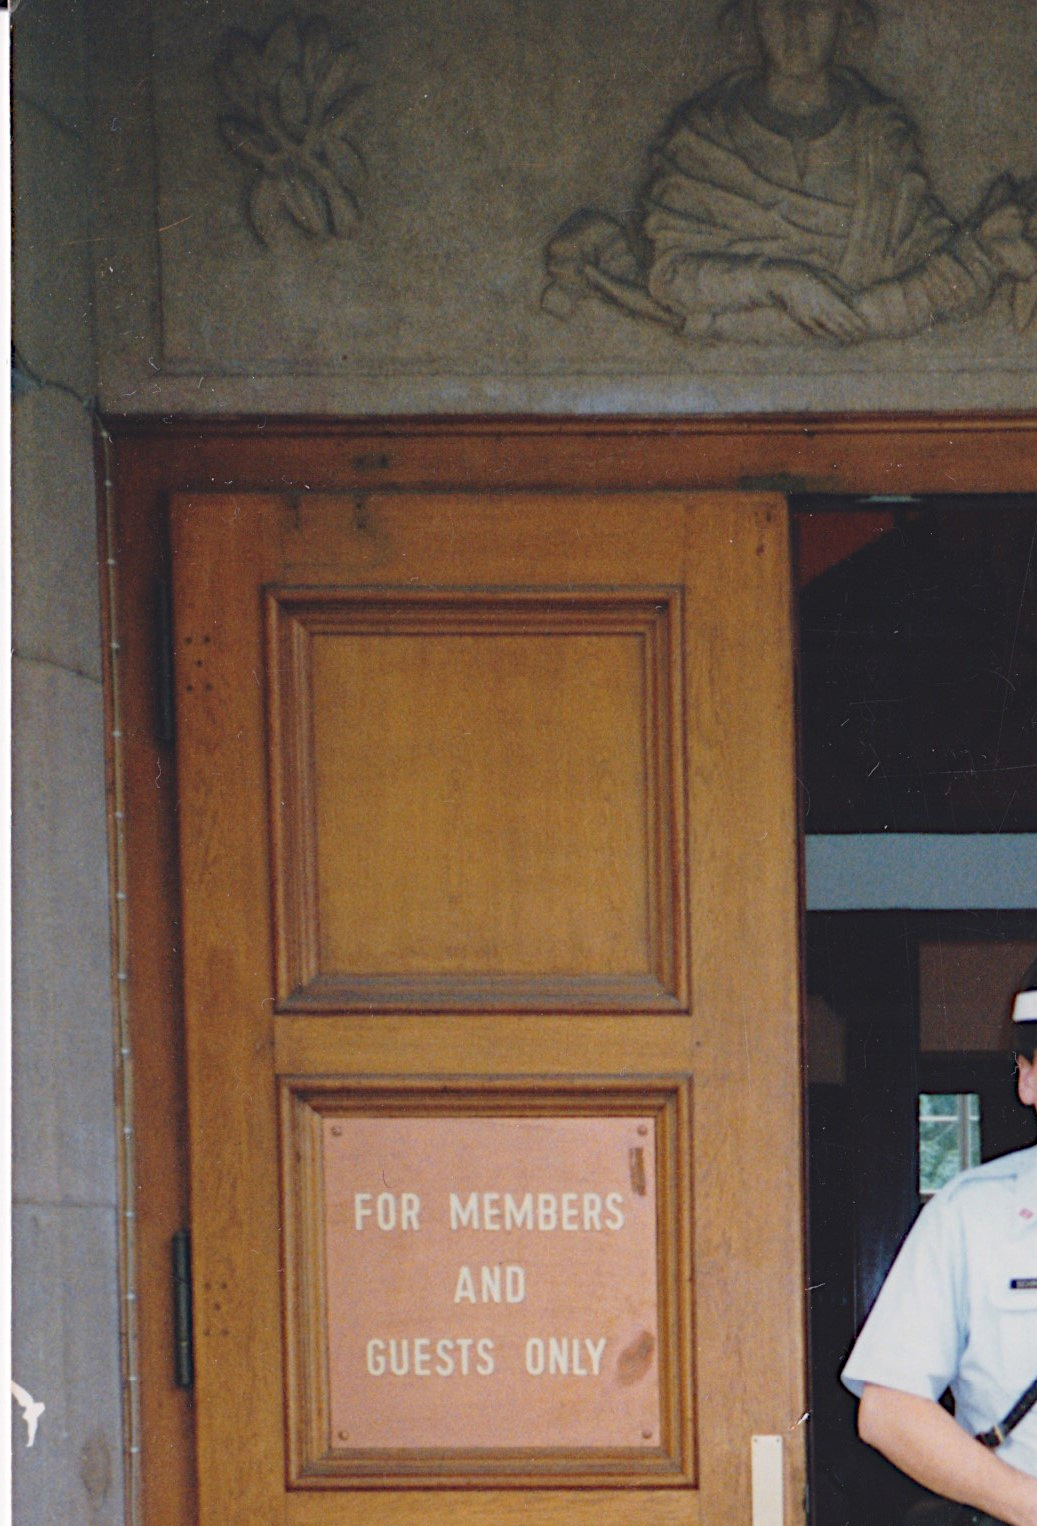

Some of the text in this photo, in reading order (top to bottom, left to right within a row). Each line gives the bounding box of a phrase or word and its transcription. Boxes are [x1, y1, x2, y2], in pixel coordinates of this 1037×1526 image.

[354, 1192, 626, 1231] FOR MEMBERS
[454, 1265, 526, 1303] AND
[366, 1338, 607, 1376] GUESTS ONLY
